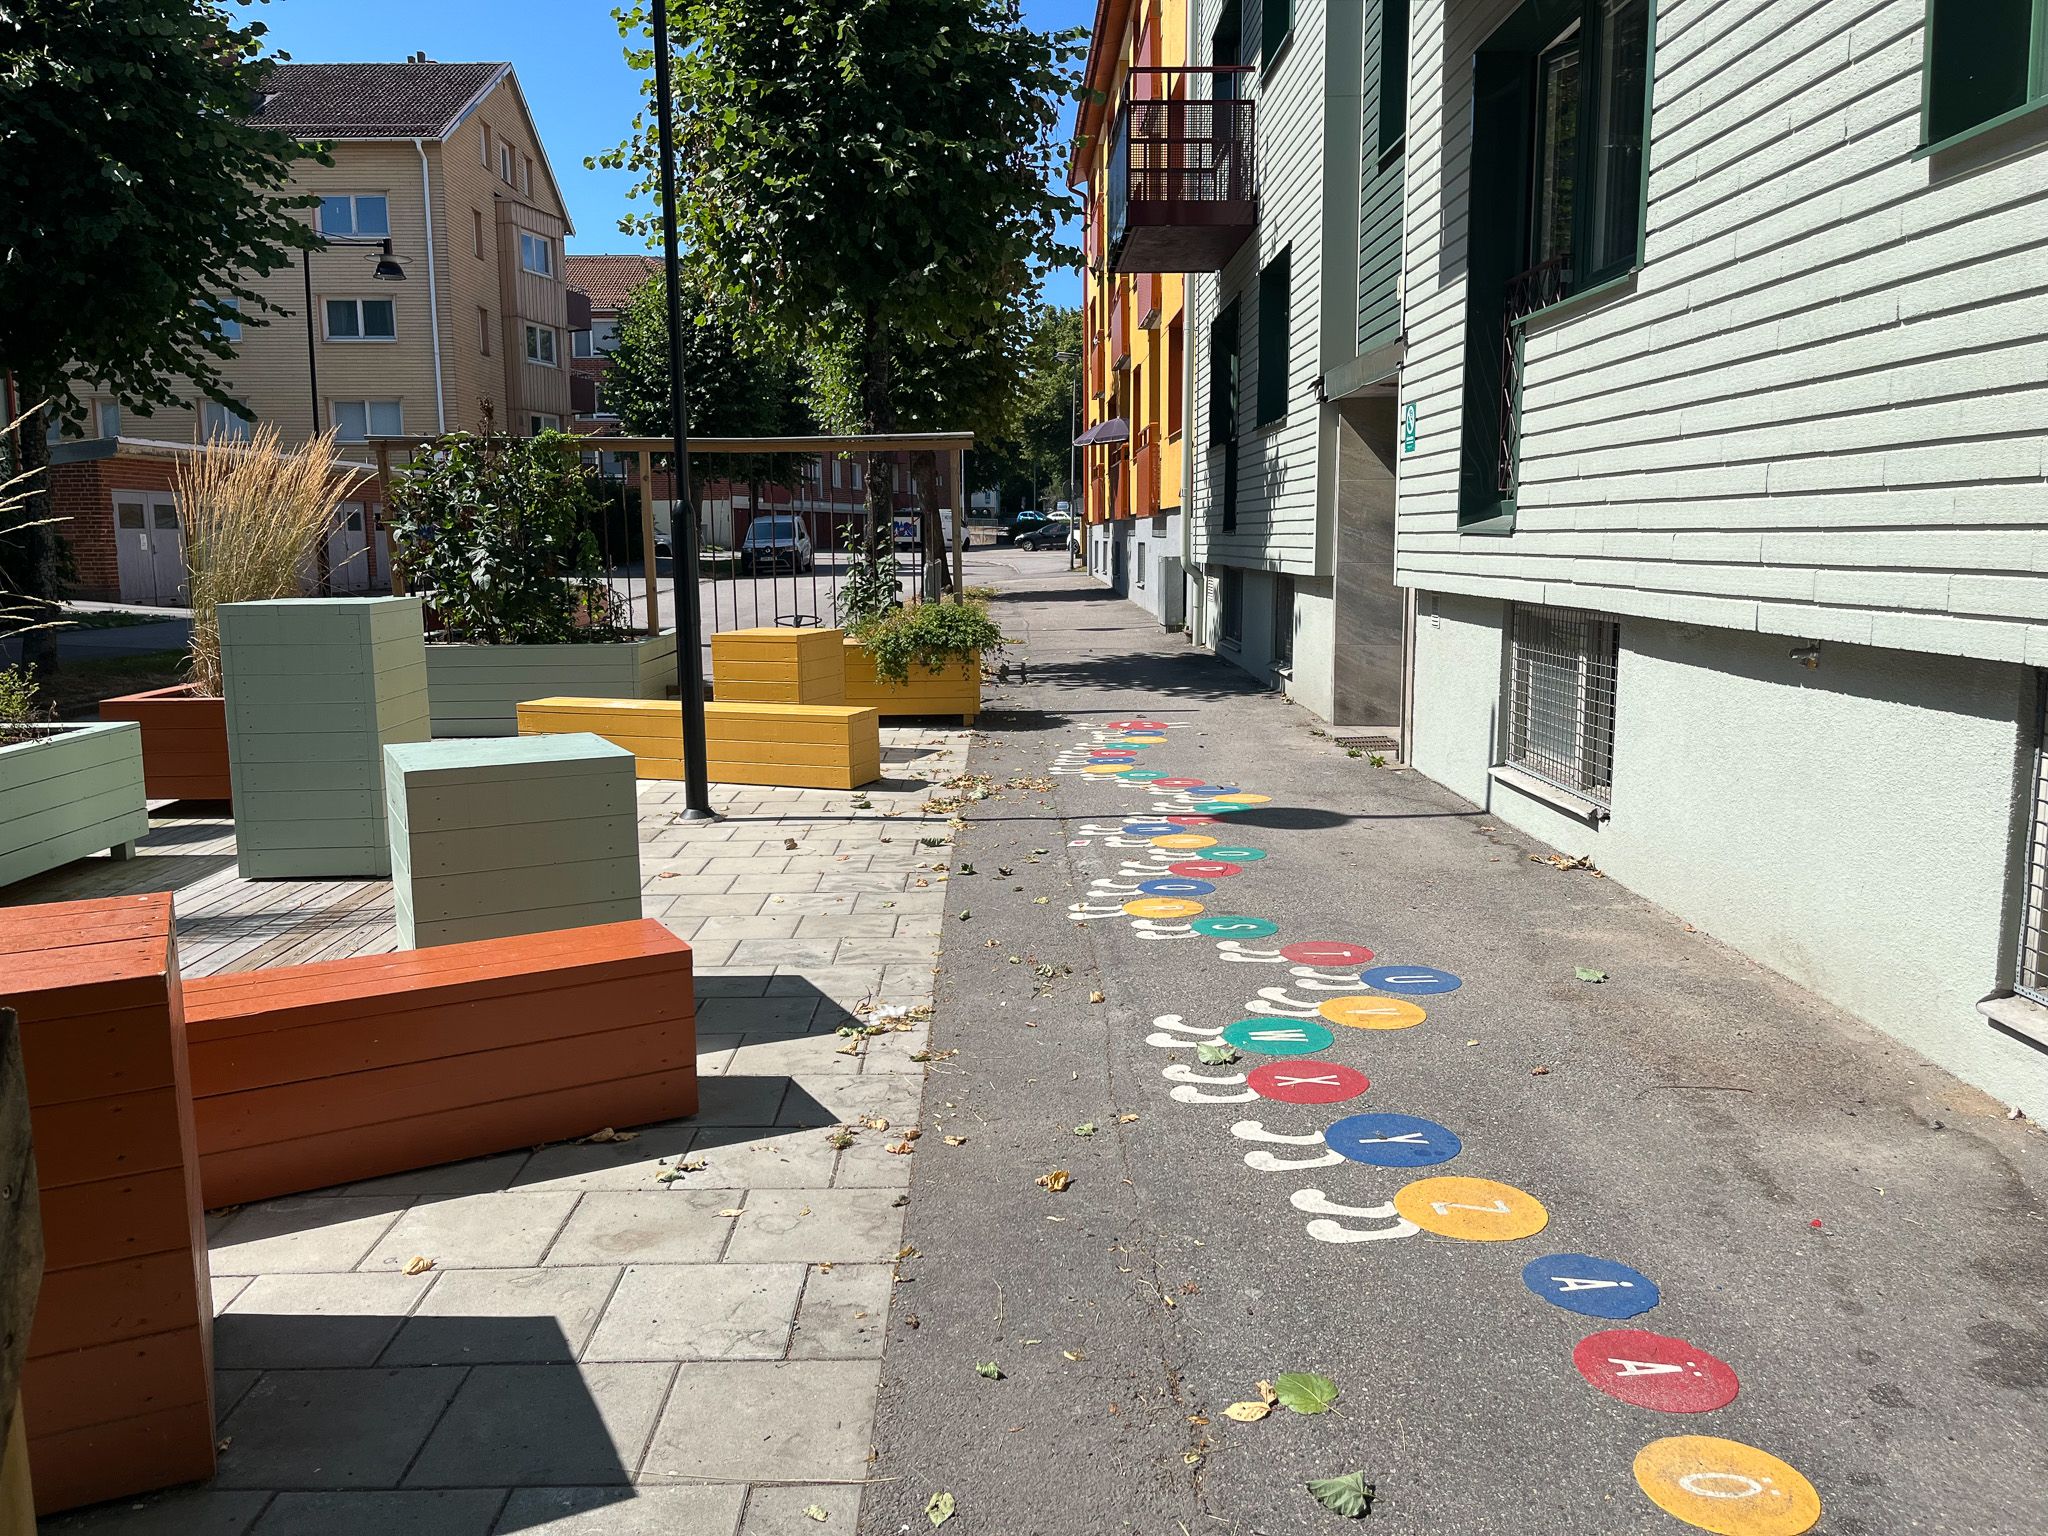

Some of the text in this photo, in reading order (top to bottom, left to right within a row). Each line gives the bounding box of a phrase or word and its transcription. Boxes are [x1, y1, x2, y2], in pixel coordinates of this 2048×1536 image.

[1384, 975, 1439, 984] U
[1345, 1008, 1401, 1016] V
[1248, 1028, 1309, 1042] W
[1274, 1074, 1341, 1087] X
[1358, 1132, 1430, 1145] Y
[1429, 1200, 1511, 1216] Z
[1550, 1276, 1634, 1292] Å
[1607, 1357, 1703, 1377] Ä
[1678, 1472, 1781, 1499] Ö
